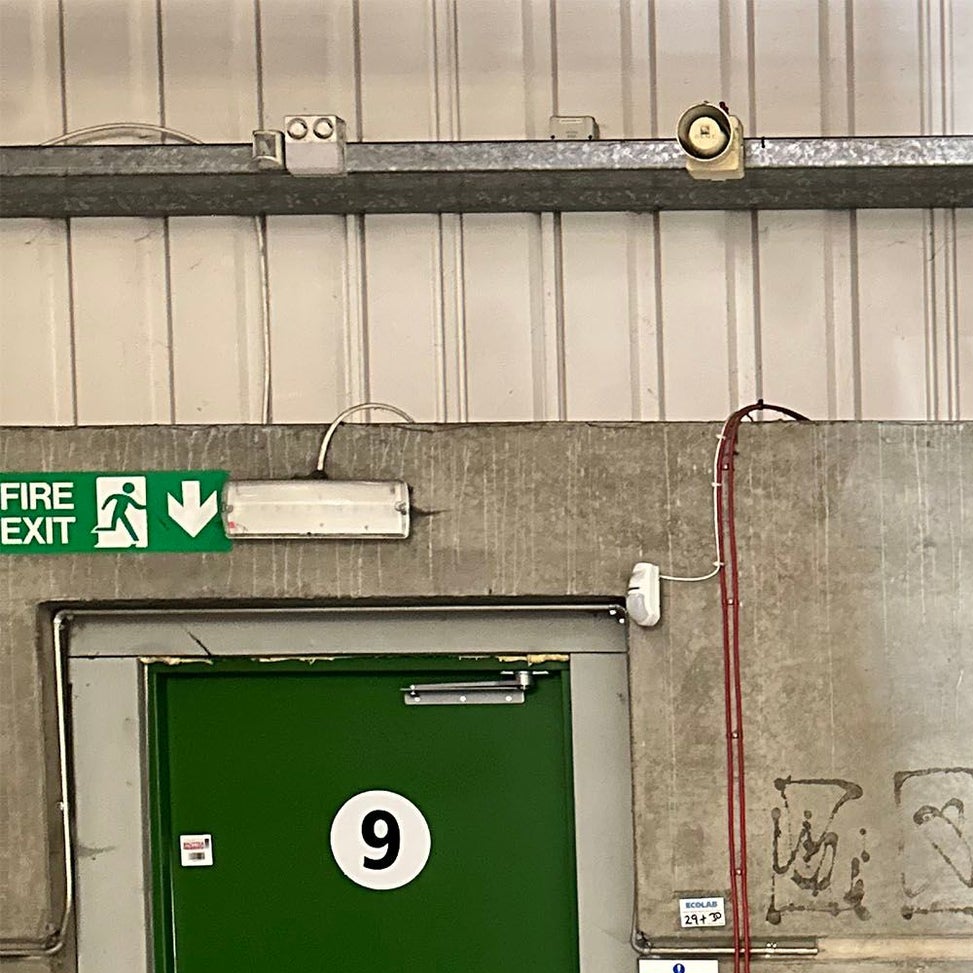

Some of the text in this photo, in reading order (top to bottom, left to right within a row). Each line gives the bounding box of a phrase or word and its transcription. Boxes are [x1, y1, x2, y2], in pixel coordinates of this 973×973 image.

[0, 482, 74, 510] FIRE
[0, 516, 76, 545] EXIT
[361, 809, 401, 871] 9
[684, 914, 698, 925] 29
[709, 911, 722, 922] 30
